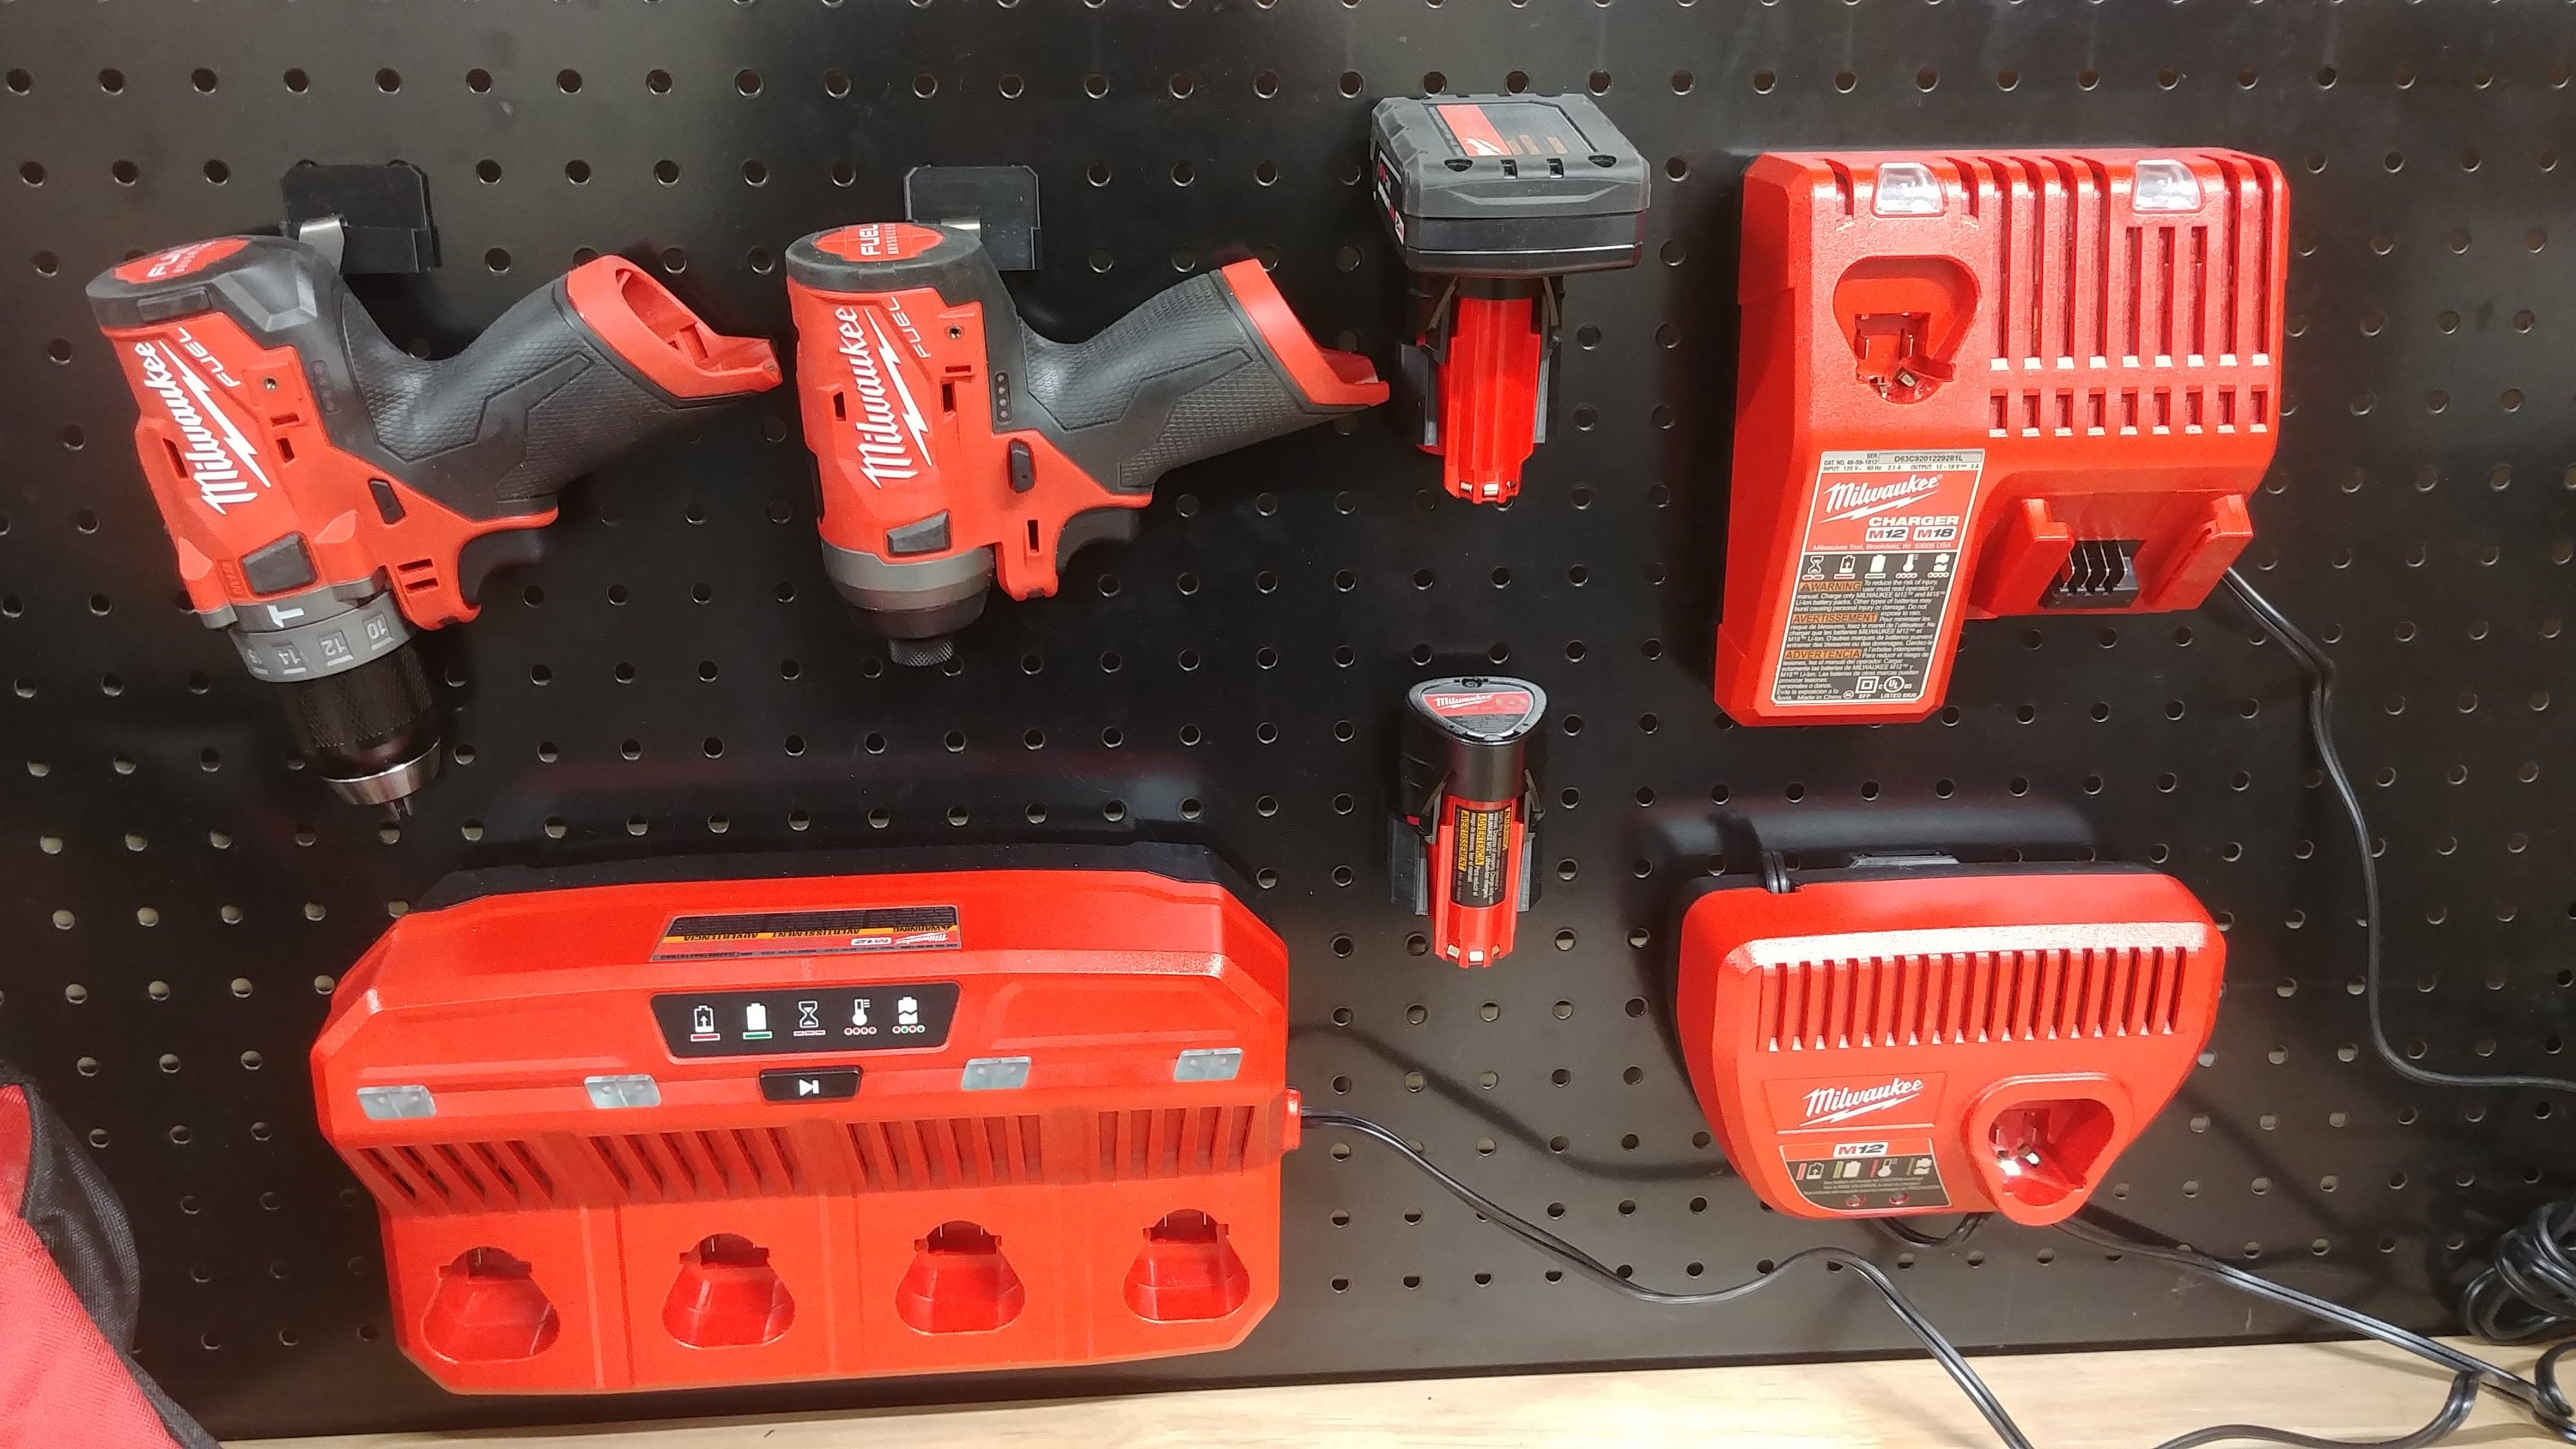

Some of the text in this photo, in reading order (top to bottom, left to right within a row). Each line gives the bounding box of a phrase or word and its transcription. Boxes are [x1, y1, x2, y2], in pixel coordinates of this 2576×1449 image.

[859, 224, 882, 256] FUEL
[888, 296, 932, 358] FUEL
[178, 326, 241, 387] FUEL
[833, 306, 919, 489] Milwaukee
[134, 342, 258, 515] Milwaukee
[1868, 515, 1959, 527] CHARGER
[1868, 528, 1954, 539] M12 M18
[1811, 582, 1861, 591] WARNING
[1794, 614, 1877, 622] AVERTISSEMENT
[367, 620, 386, 640] 10
[278, 649, 301, 665] 14
[320, 638, 346, 657] 12
[1786, 650, 1859, 658] ADVERTENCIA
[1432, 694, 1493, 707] Milwaukee
[1459, 812, 1468, 869] AVERTISSEMENT
[1476, 815, 1486, 863] ADVERTENCIA
[1802, 1077, 1923, 1118] Milwaukee
[1838, 1144, 1885, 1155] M12
